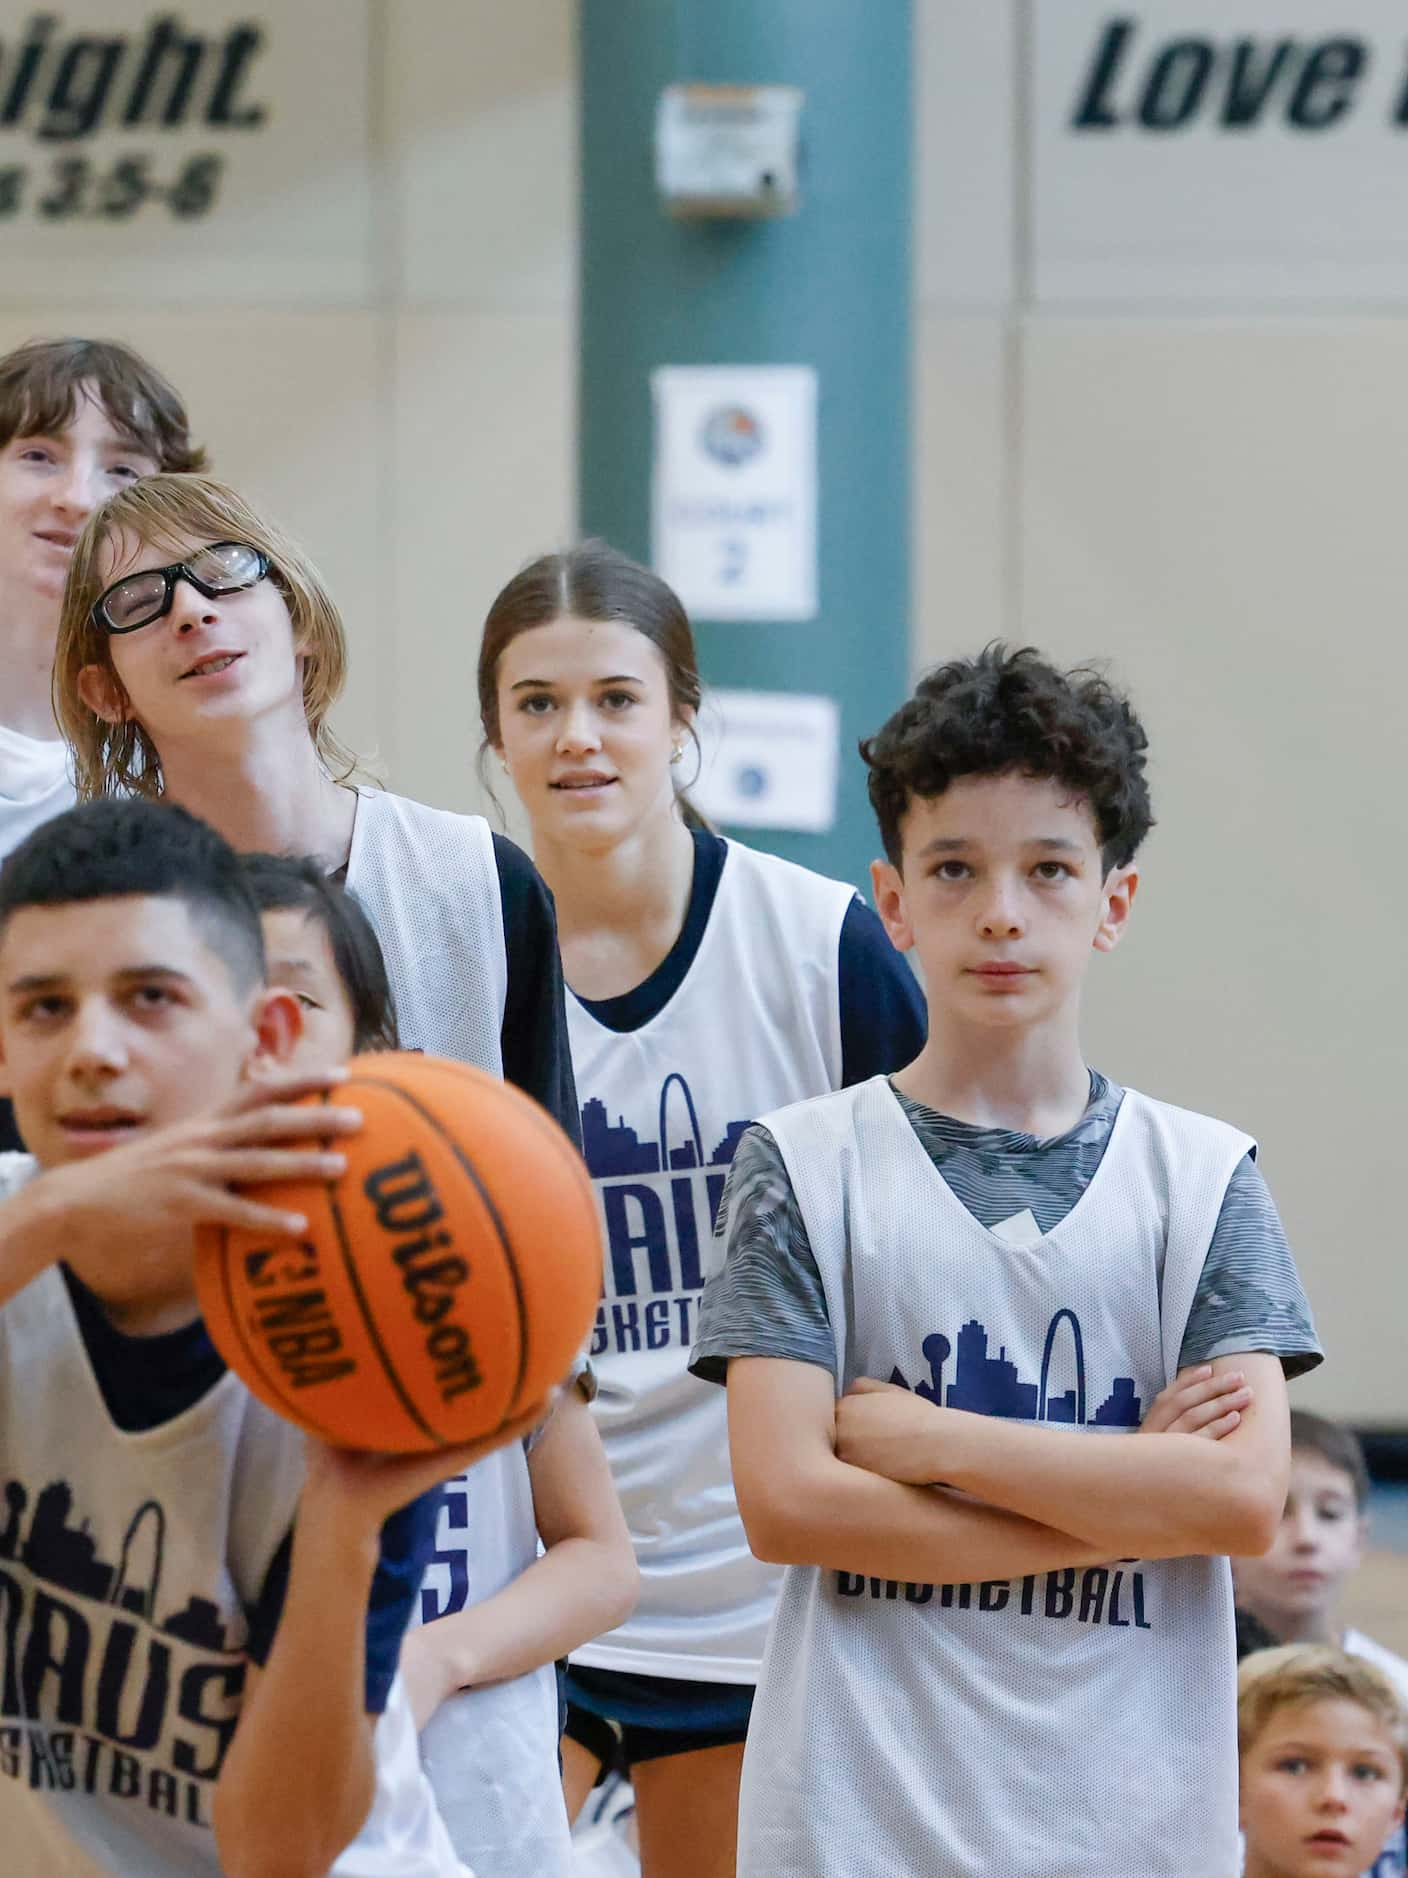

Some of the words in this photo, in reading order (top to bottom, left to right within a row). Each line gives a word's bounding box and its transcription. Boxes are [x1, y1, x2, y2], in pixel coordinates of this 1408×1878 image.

[1068, 17, 1369, 132] Love
[35, 150, 223, 222] 3:5-6
[363, 1146, 484, 1405] Wilson
[255, 1289, 356, 1388] NBA
